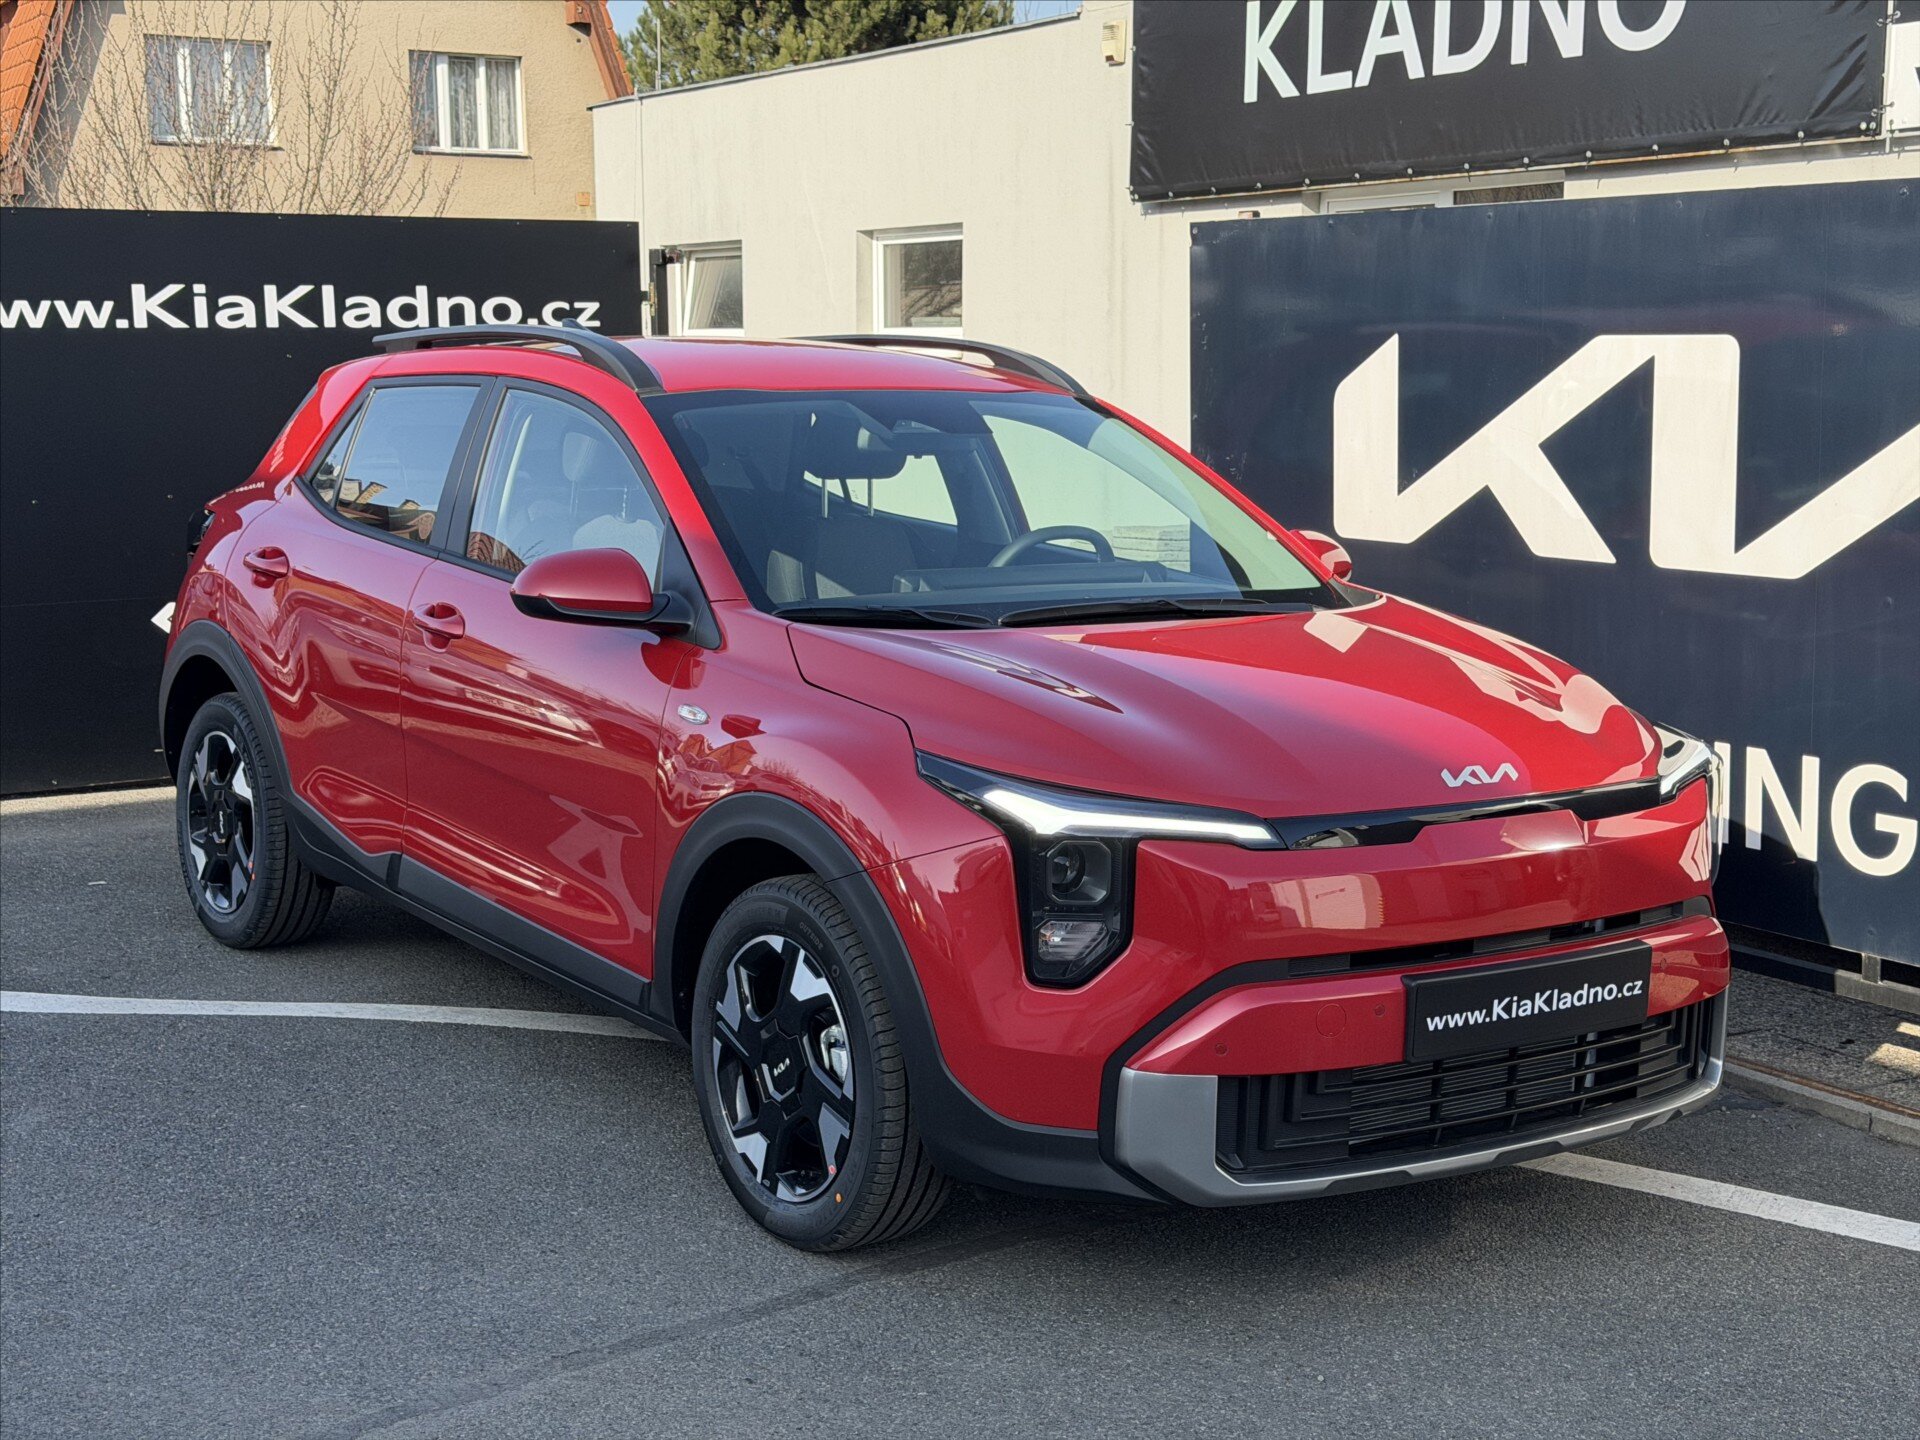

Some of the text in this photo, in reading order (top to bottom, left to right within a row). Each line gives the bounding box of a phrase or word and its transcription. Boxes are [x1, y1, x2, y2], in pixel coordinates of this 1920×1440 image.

[1441, 762, 1519, 787] KIA
[799, 921, 824, 950] OUTSIDE
[1426, 979, 1643, 1031] www.KiaKladno.cz
